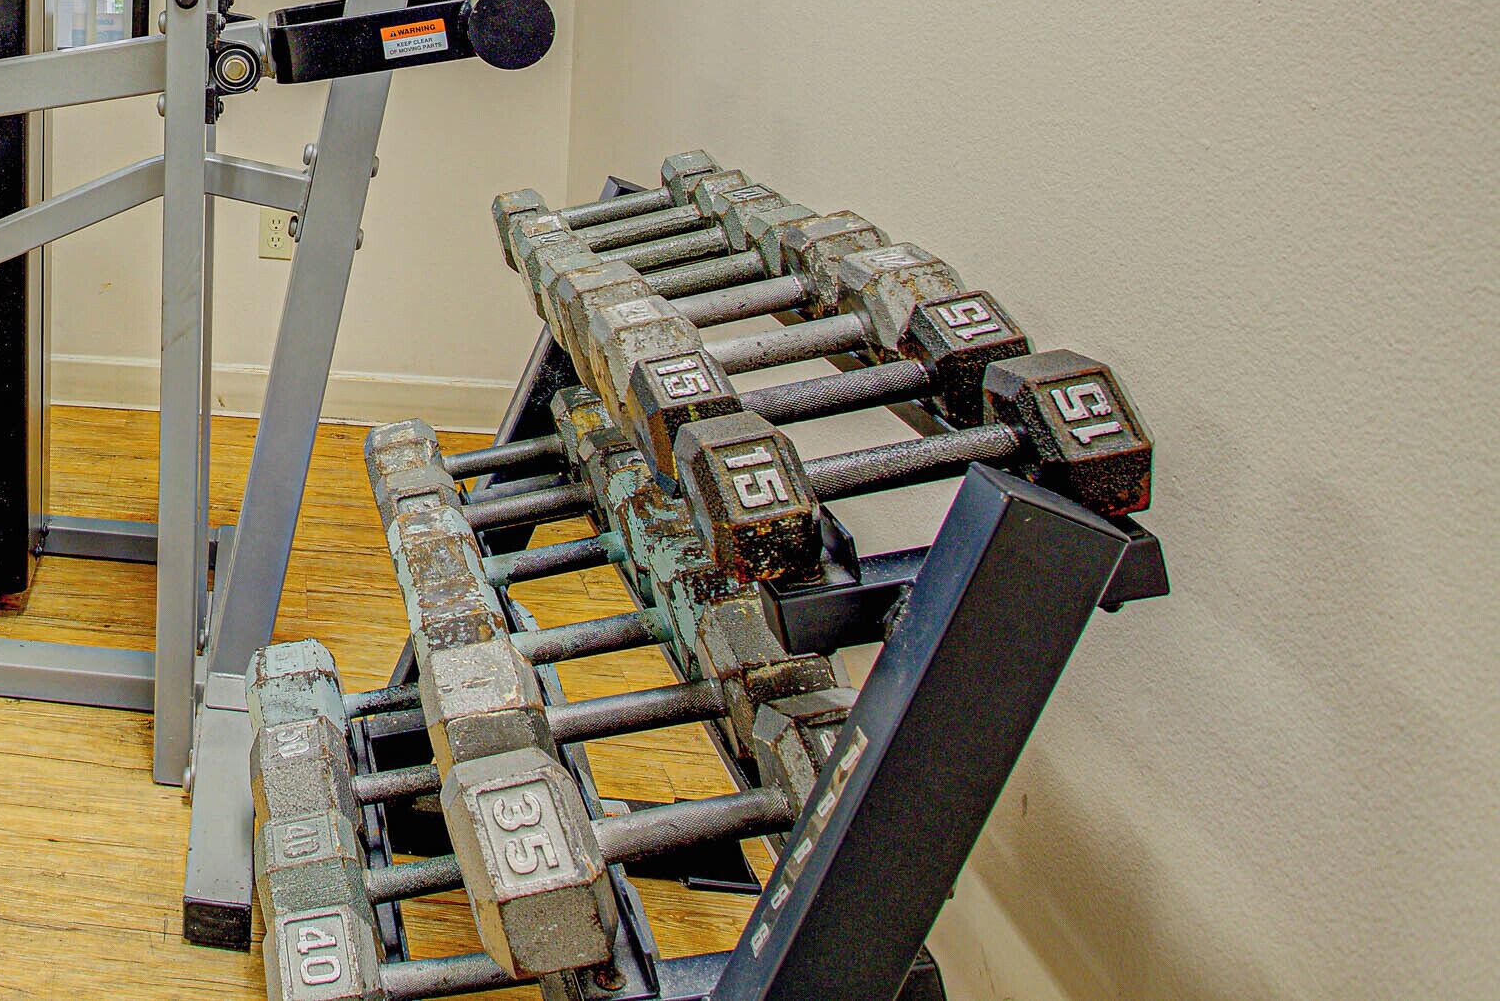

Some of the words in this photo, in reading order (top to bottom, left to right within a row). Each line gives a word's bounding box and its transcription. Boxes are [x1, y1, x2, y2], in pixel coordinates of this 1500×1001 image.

[397, 24, 436, 36] WARNING
[399, 45, 422, 53] MOVING
[422, 41, 443, 49] PARTS
[413, 37, 433, 45] CLEAR
[937, 300, 1001, 340] 15
[655, 358, 711, 399] 15
[1050, 382, 1124, 444] 15
[724, 446, 789, 508] 15
[492, 791, 559, 875] 35
[296, 929, 342, 986] 40
